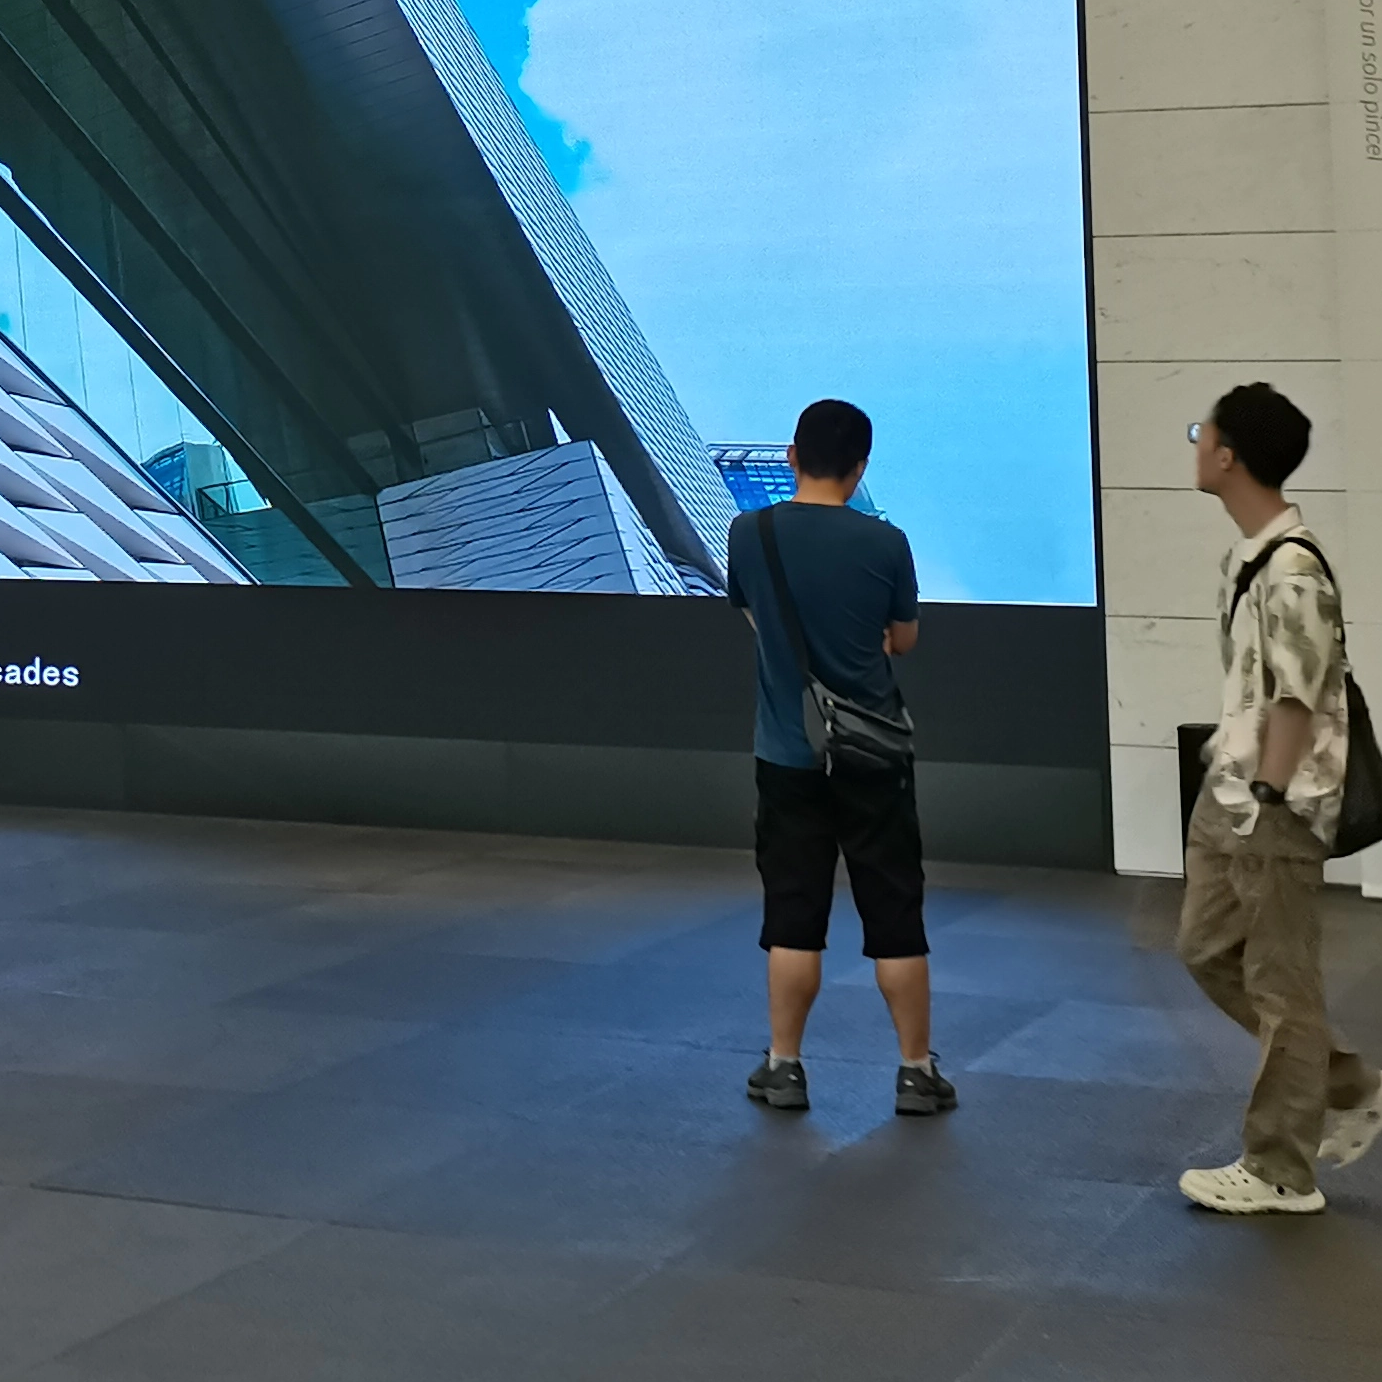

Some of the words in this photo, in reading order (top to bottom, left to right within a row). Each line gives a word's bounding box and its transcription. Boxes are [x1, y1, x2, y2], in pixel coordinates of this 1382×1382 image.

[1360, 21, 1376, 47] un
[1362, 52, 1382, 95] solo
[1359, 100, 1382, 161] pincel
